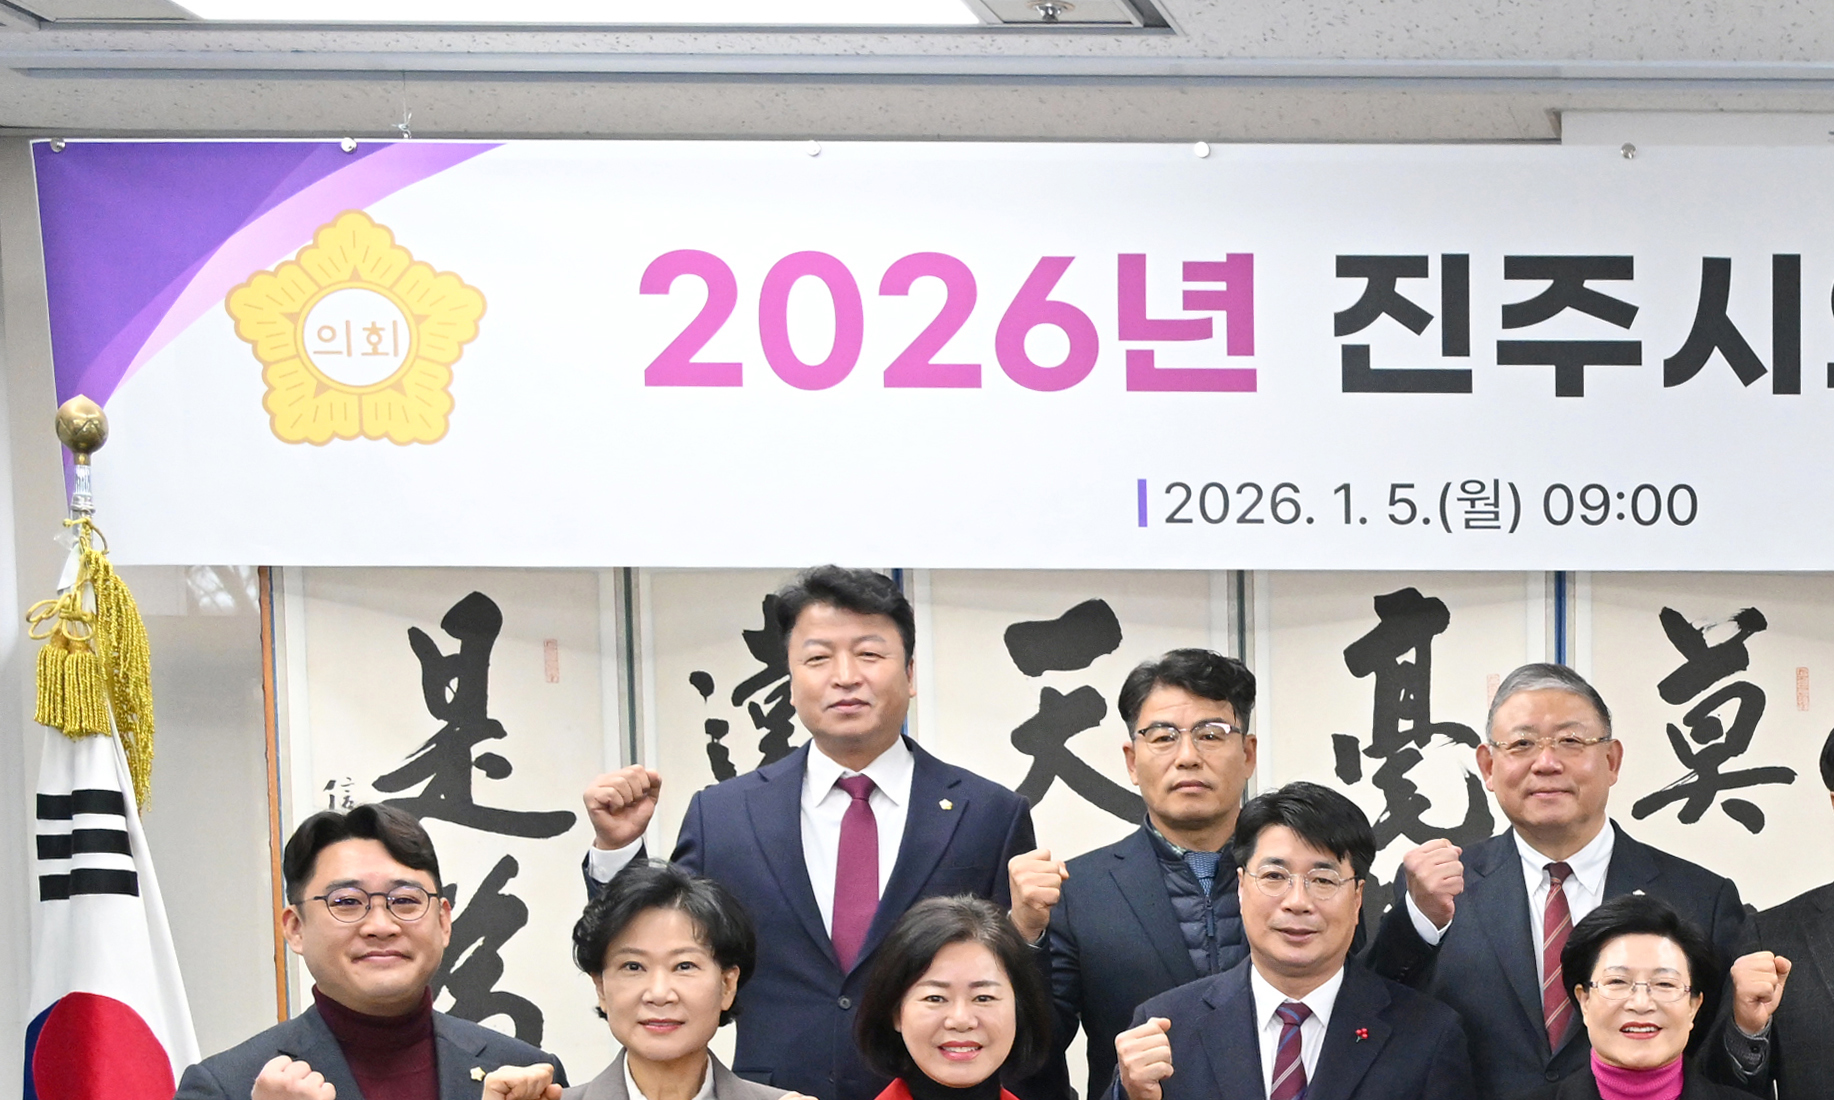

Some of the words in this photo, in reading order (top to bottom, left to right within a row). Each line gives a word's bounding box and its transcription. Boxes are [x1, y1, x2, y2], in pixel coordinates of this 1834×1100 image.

[312, 318, 403, 359] 의회
[639, 249, 1257, 392] 2026년
[1165, 482, 1313, 524] 2026.
[1334, 483, 1367, 524] 1.
[1388, 479, 1521, 533] 5.(월)
[1543, 483, 1697, 526] 09:00
